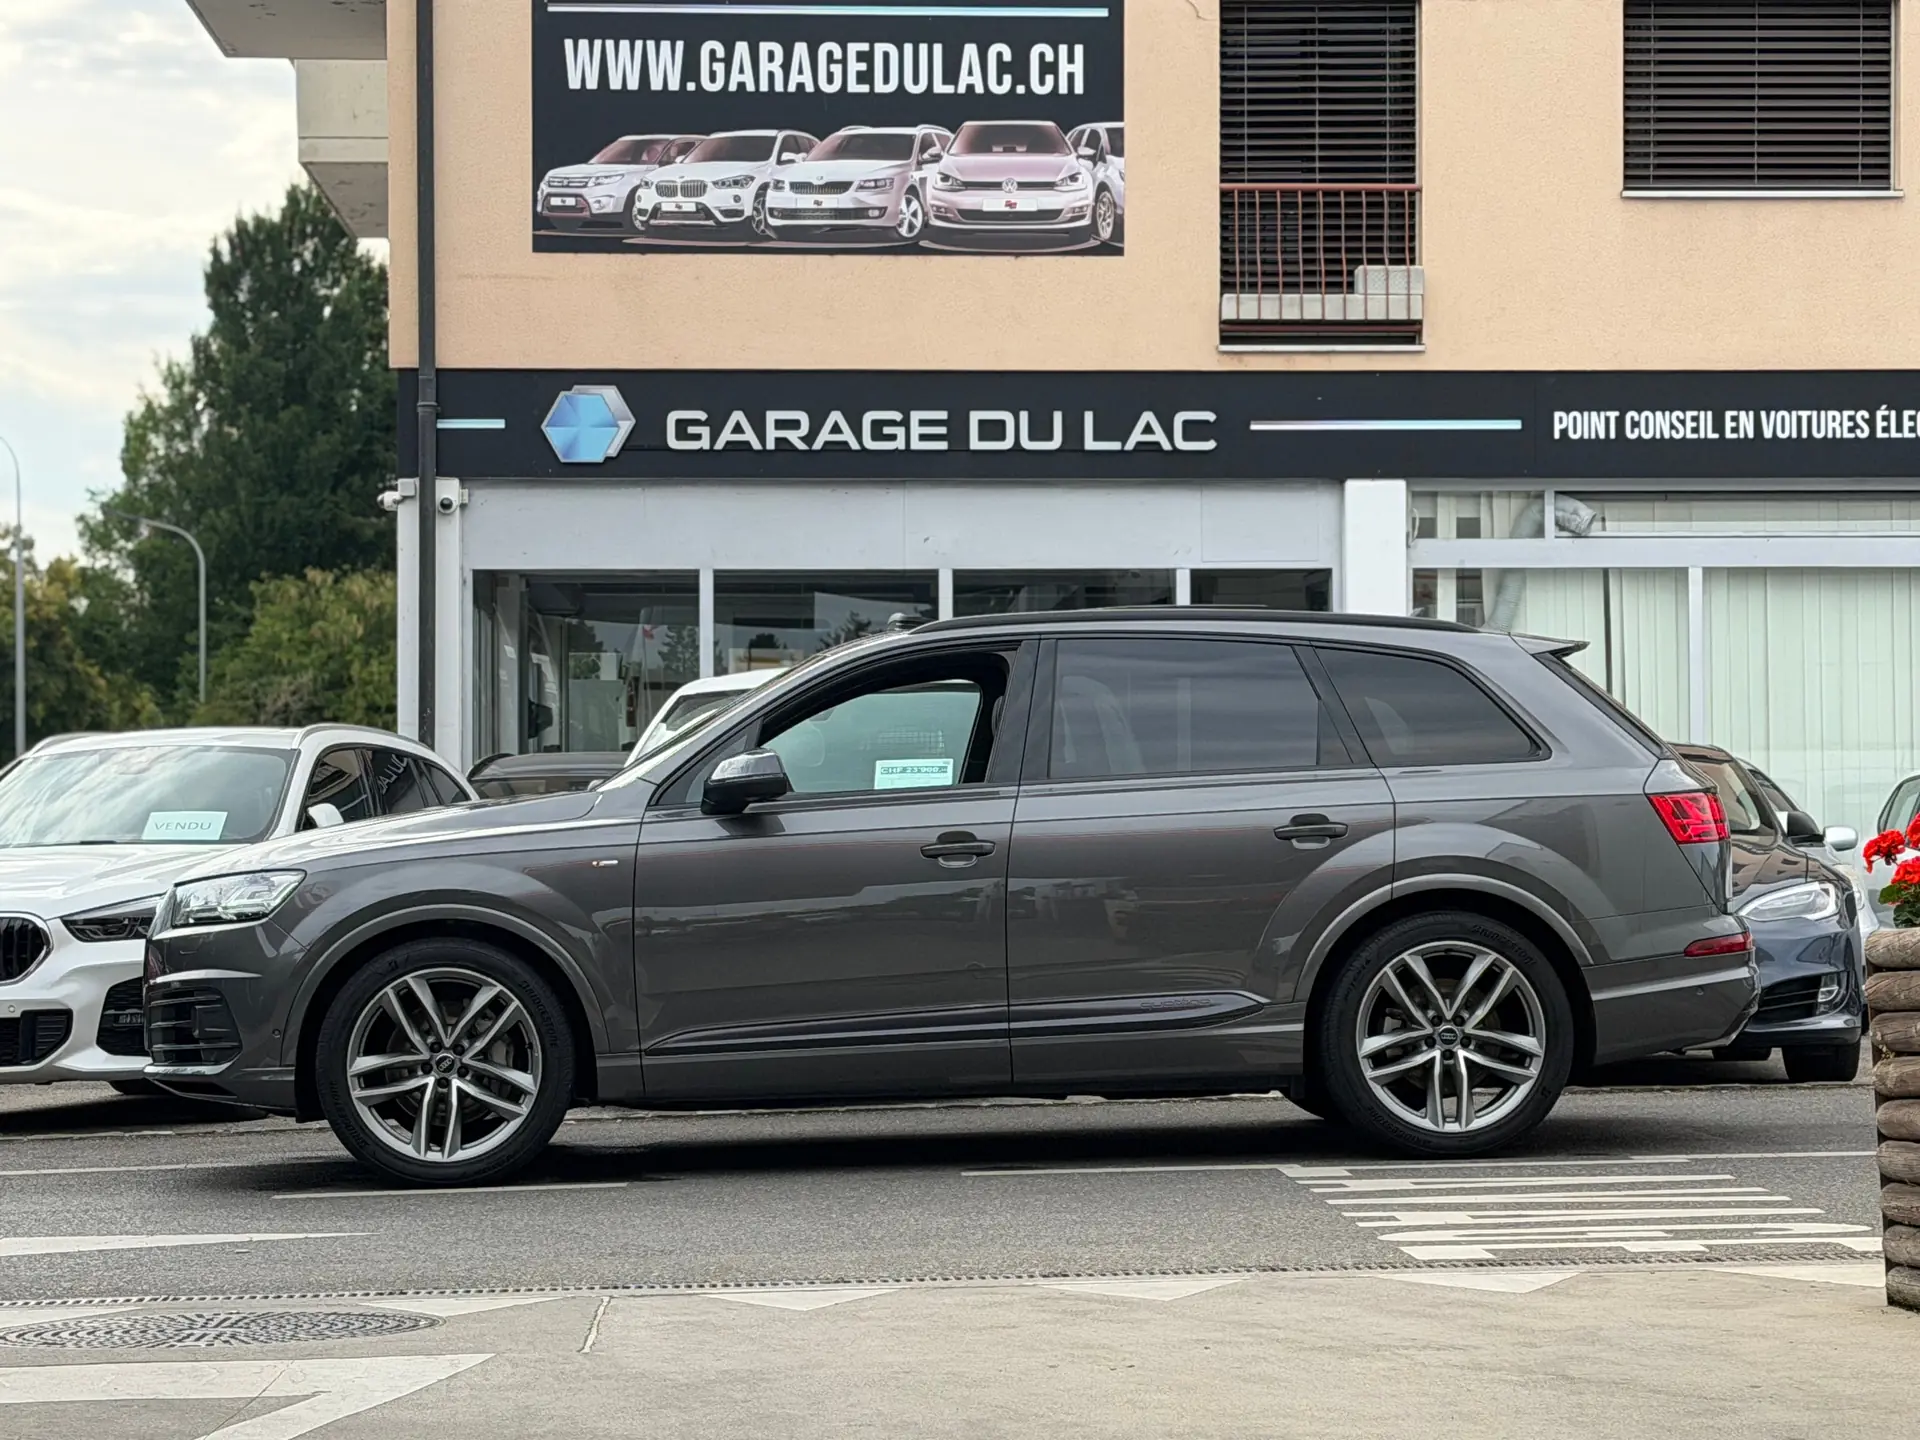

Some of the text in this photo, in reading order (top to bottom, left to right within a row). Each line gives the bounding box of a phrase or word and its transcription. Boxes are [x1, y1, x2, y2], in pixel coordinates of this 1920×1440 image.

[564, 38, 1084, 95] WWW.GARAGEDULAC.CH
[666, 410, 1218, 451] GARAGE DU LAC
[1553, 404, 1920, 440] POINT CONSEIL EN VOITURES ÉLE
[155, 821, 212, 831] VENDU
